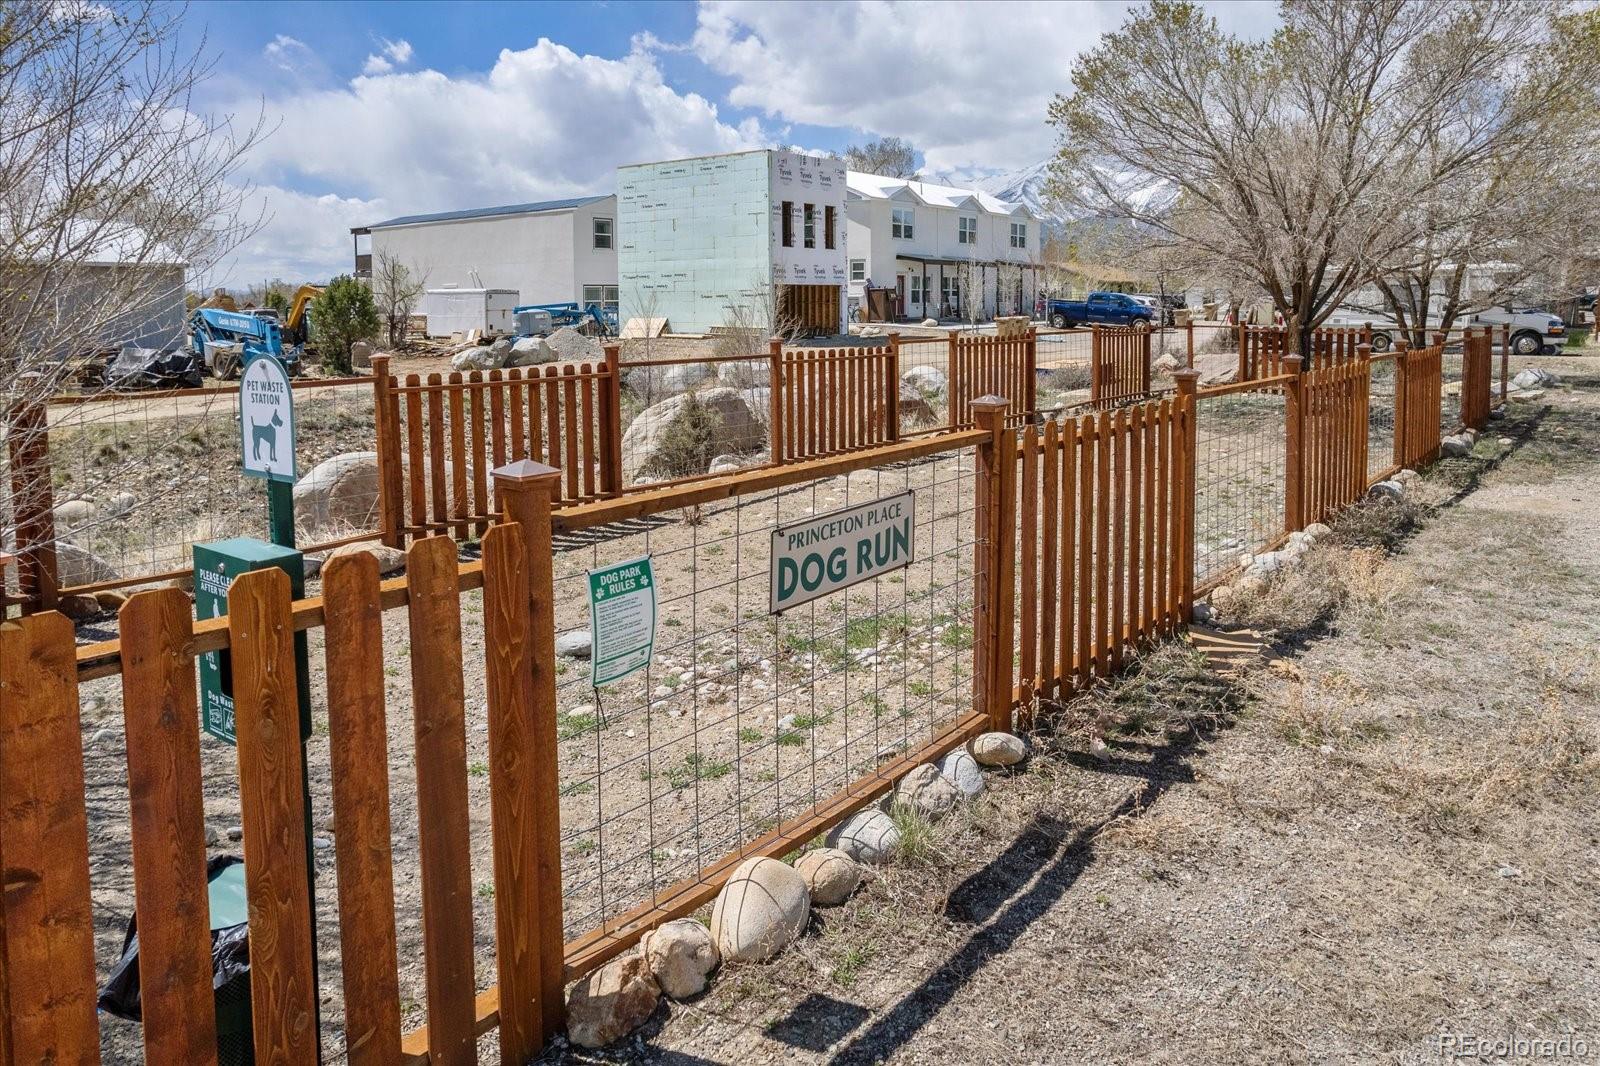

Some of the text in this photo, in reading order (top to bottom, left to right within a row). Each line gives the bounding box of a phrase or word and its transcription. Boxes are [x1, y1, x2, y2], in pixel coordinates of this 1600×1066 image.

[247, 380, 284, 393] PET WASTE
[251, 392, 280, 405] STATION
[788, 502, 902, 551] PRINCETON PLACE
[777, 516, 909, 602] DOG RUN
[199, 568, 220, 584] PLEASE
[600, 565, 642, 586] DOG PARK
[200, 582, 218, 595] AFTER
[609, 578, 636, 595] RULES
[207, 689, 219, 705] Dog
